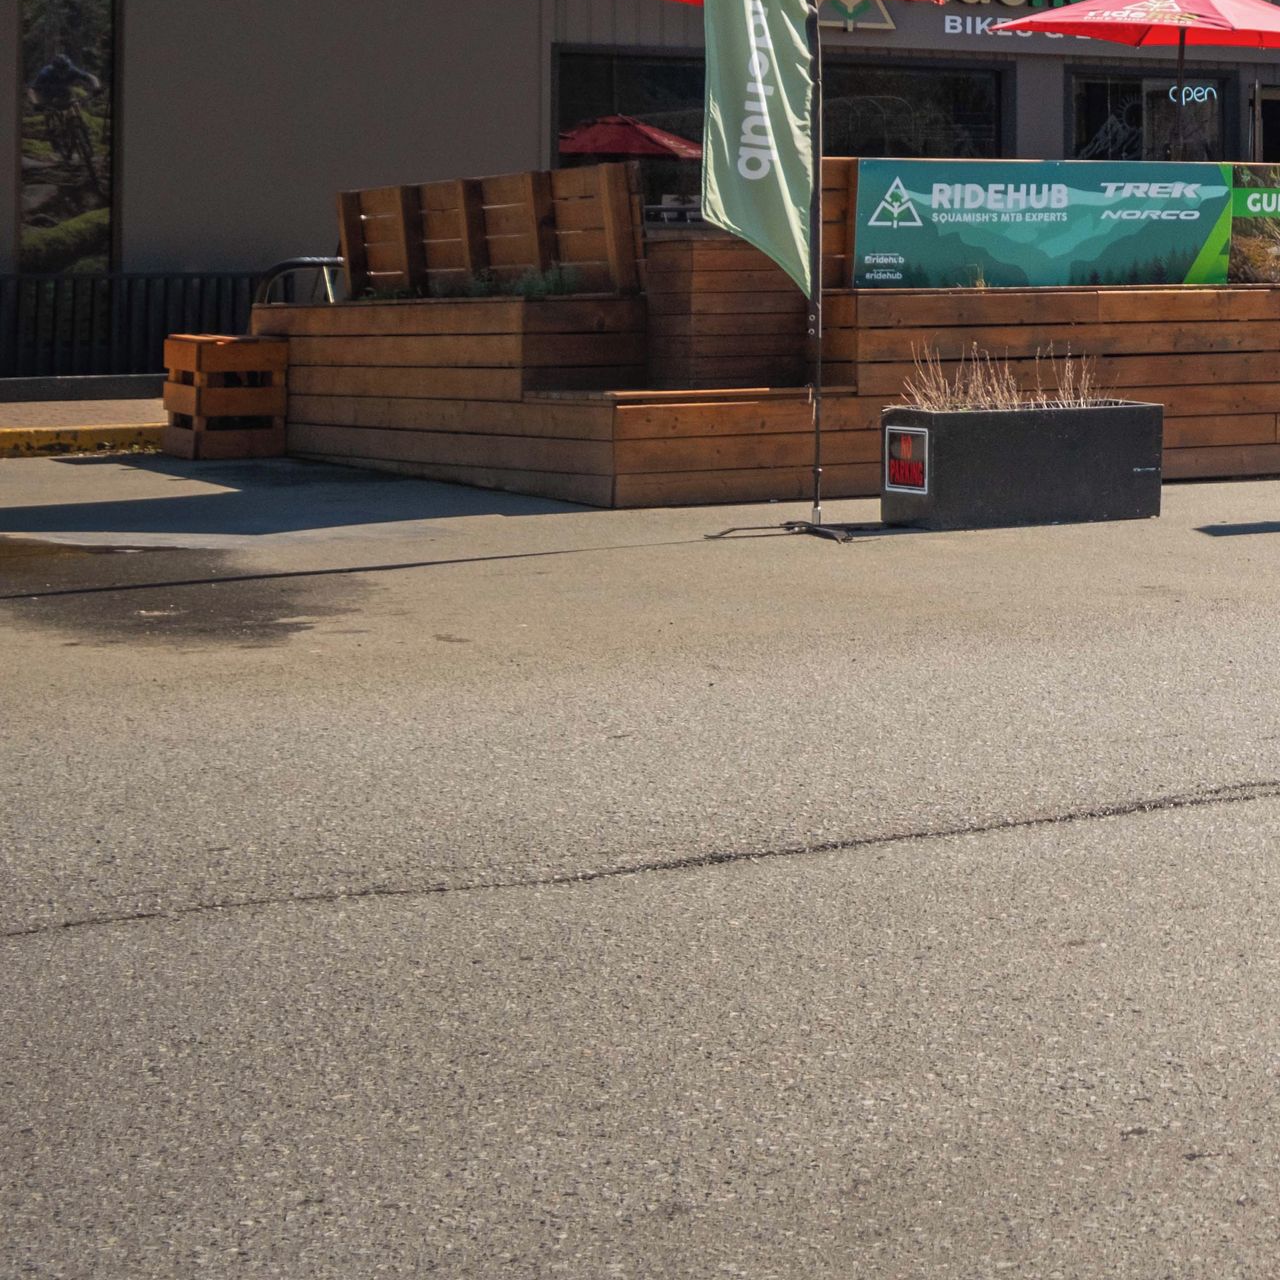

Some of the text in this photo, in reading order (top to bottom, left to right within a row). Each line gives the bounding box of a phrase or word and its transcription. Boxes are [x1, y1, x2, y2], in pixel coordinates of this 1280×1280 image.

[931, 183, 1069, 209] RIDEHUB
[1100, 182, 1202, 198] TREK
[932, 212, 1068, 223] SQUAMISH'S MTB EXPERTS
[1100, 210, 1200, 220] NORCO
[900, 432, 912, 459] NO
[889, 458, 924, 487] PARKING
